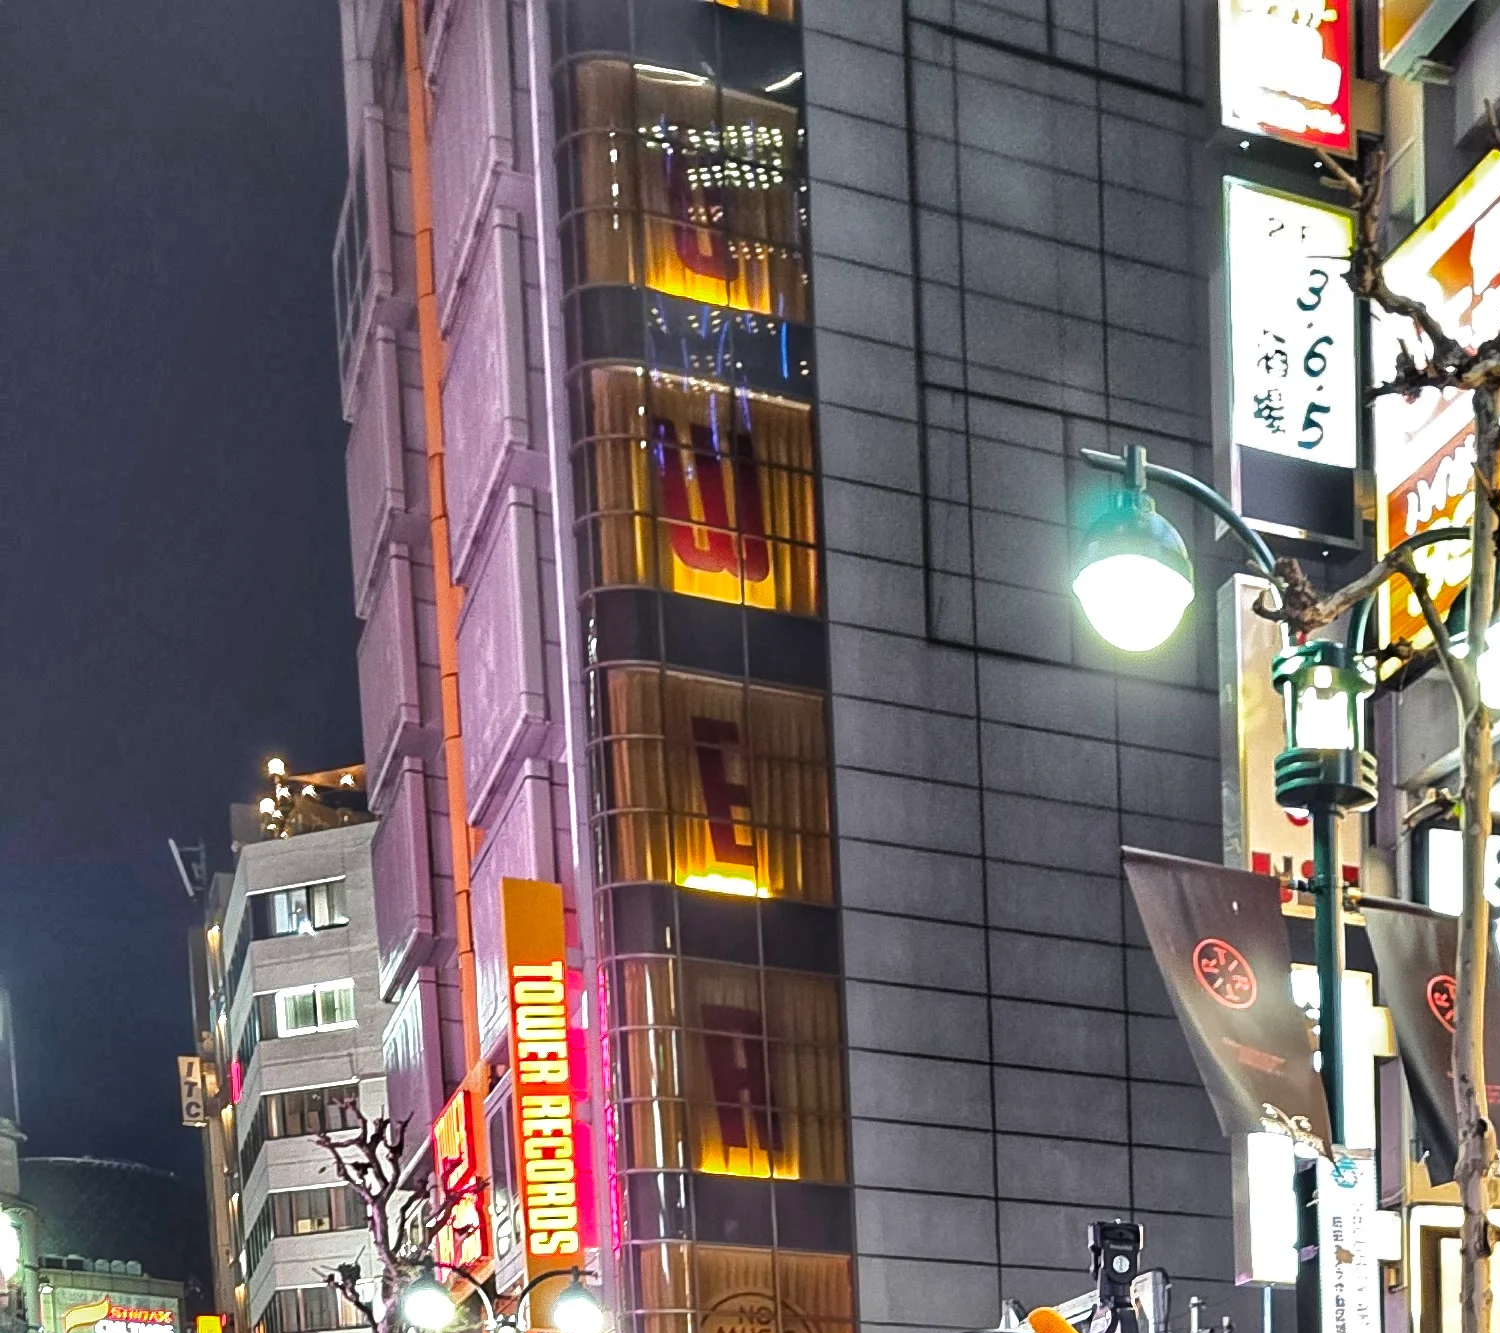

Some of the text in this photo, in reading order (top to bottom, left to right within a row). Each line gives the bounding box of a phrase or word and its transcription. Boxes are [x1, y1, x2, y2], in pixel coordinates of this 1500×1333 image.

[510, 960, 580, 1257] TOWER RECORDS
[738, 1305, 774, 1325] NO
